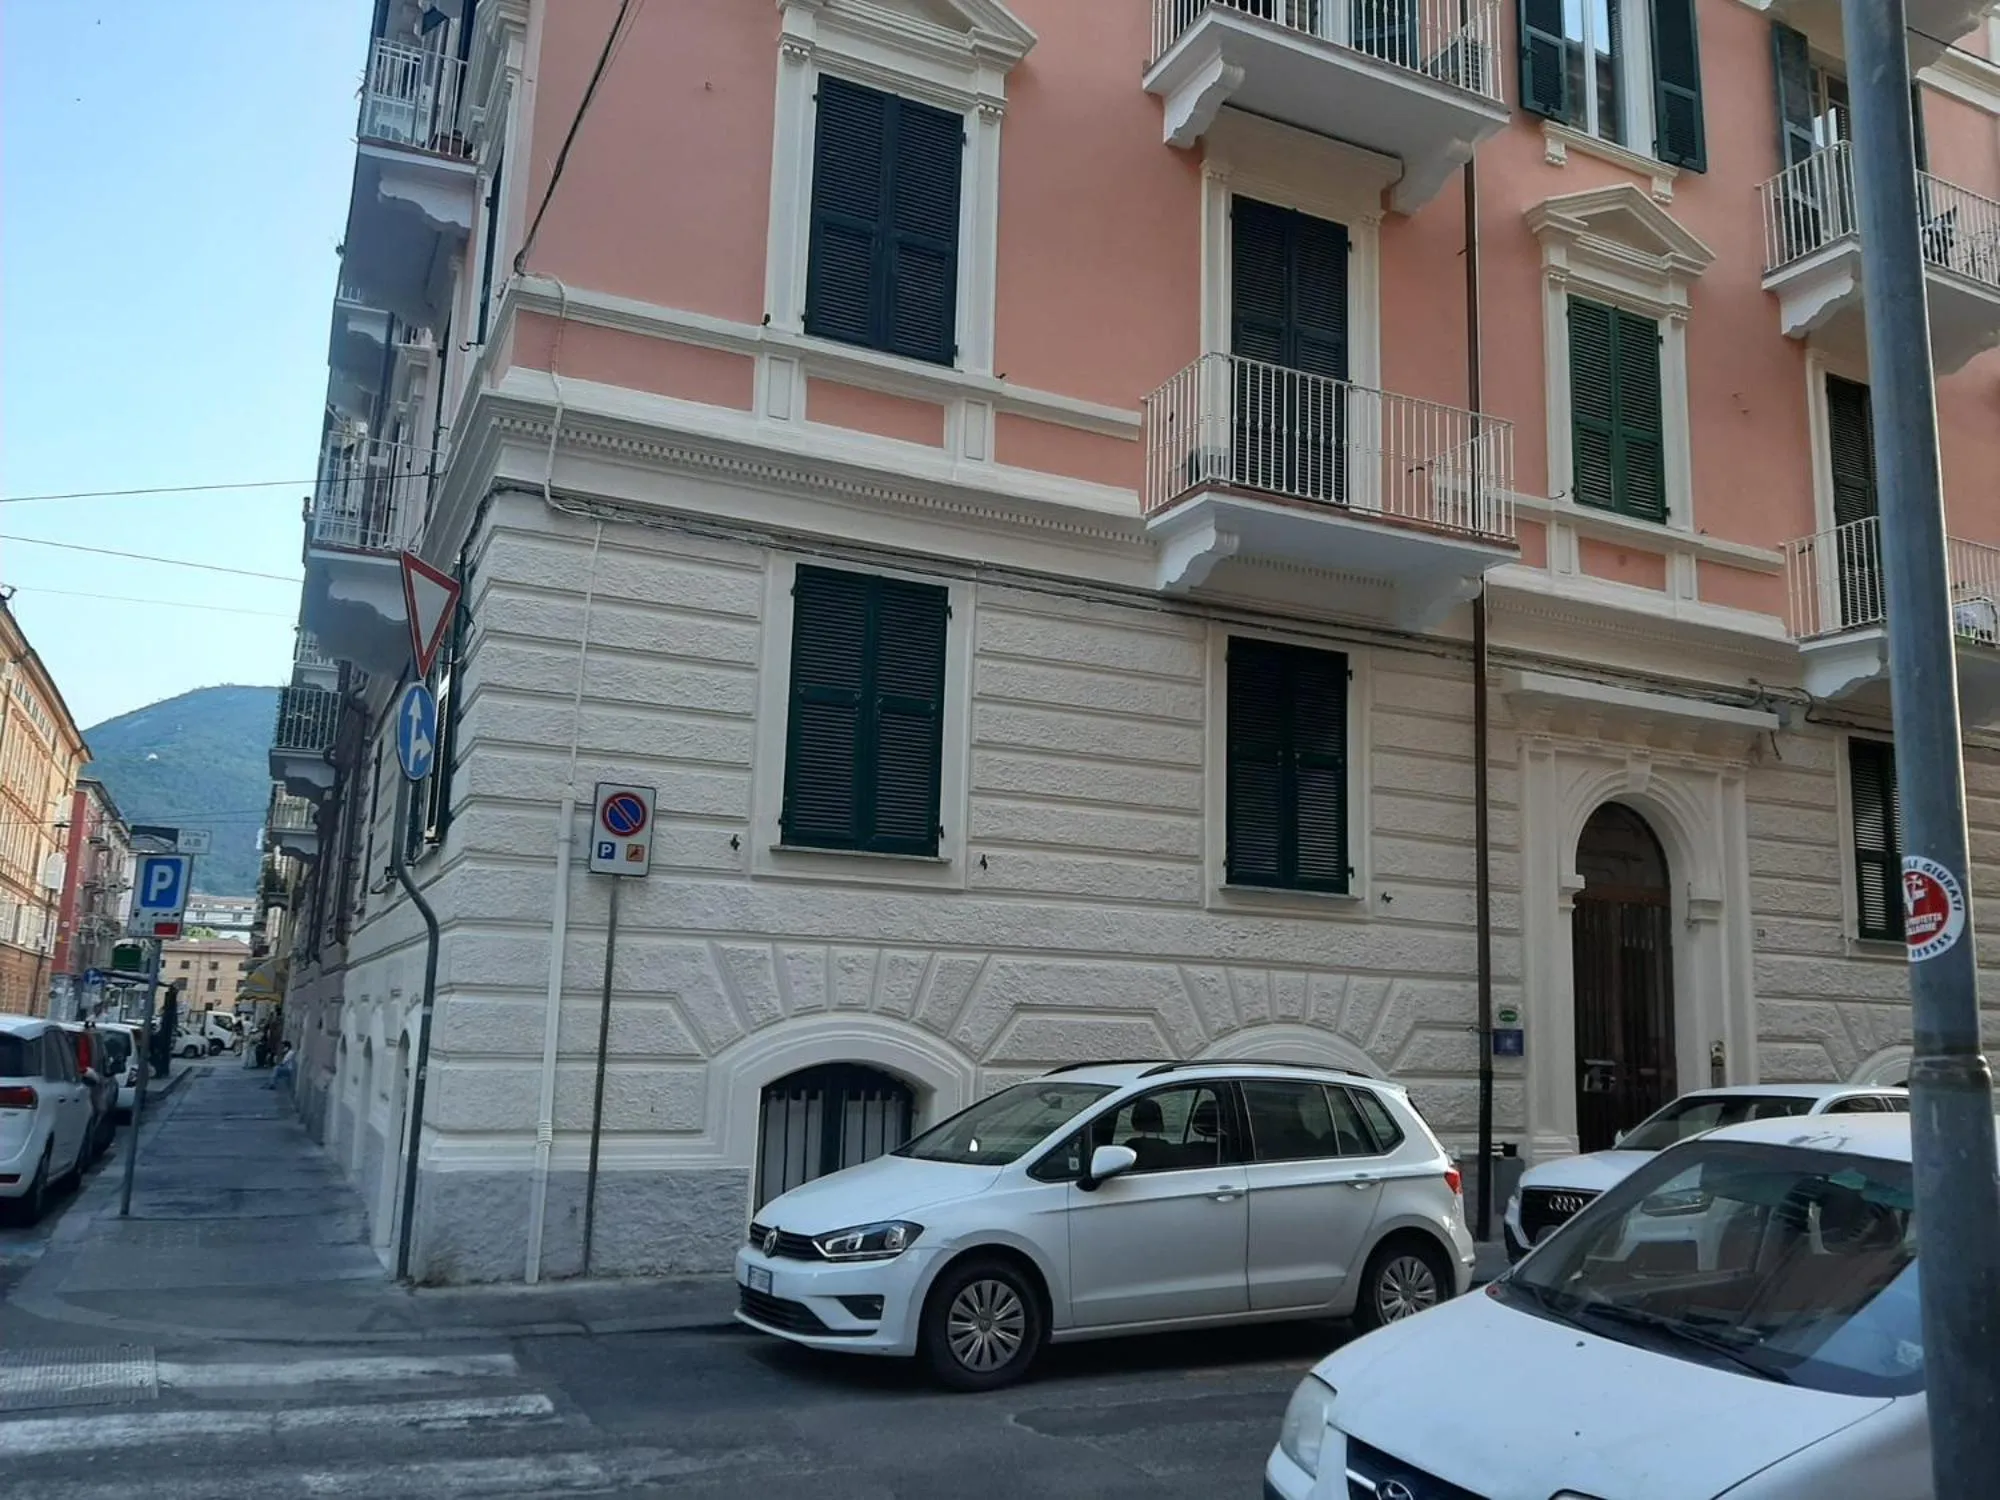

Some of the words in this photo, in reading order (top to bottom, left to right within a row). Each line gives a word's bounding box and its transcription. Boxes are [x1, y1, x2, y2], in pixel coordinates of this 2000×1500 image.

[601, 844, 612, 857] P
[148, 864, 174, 902] P
[1922, 863, 1963, 912] GIURATI
